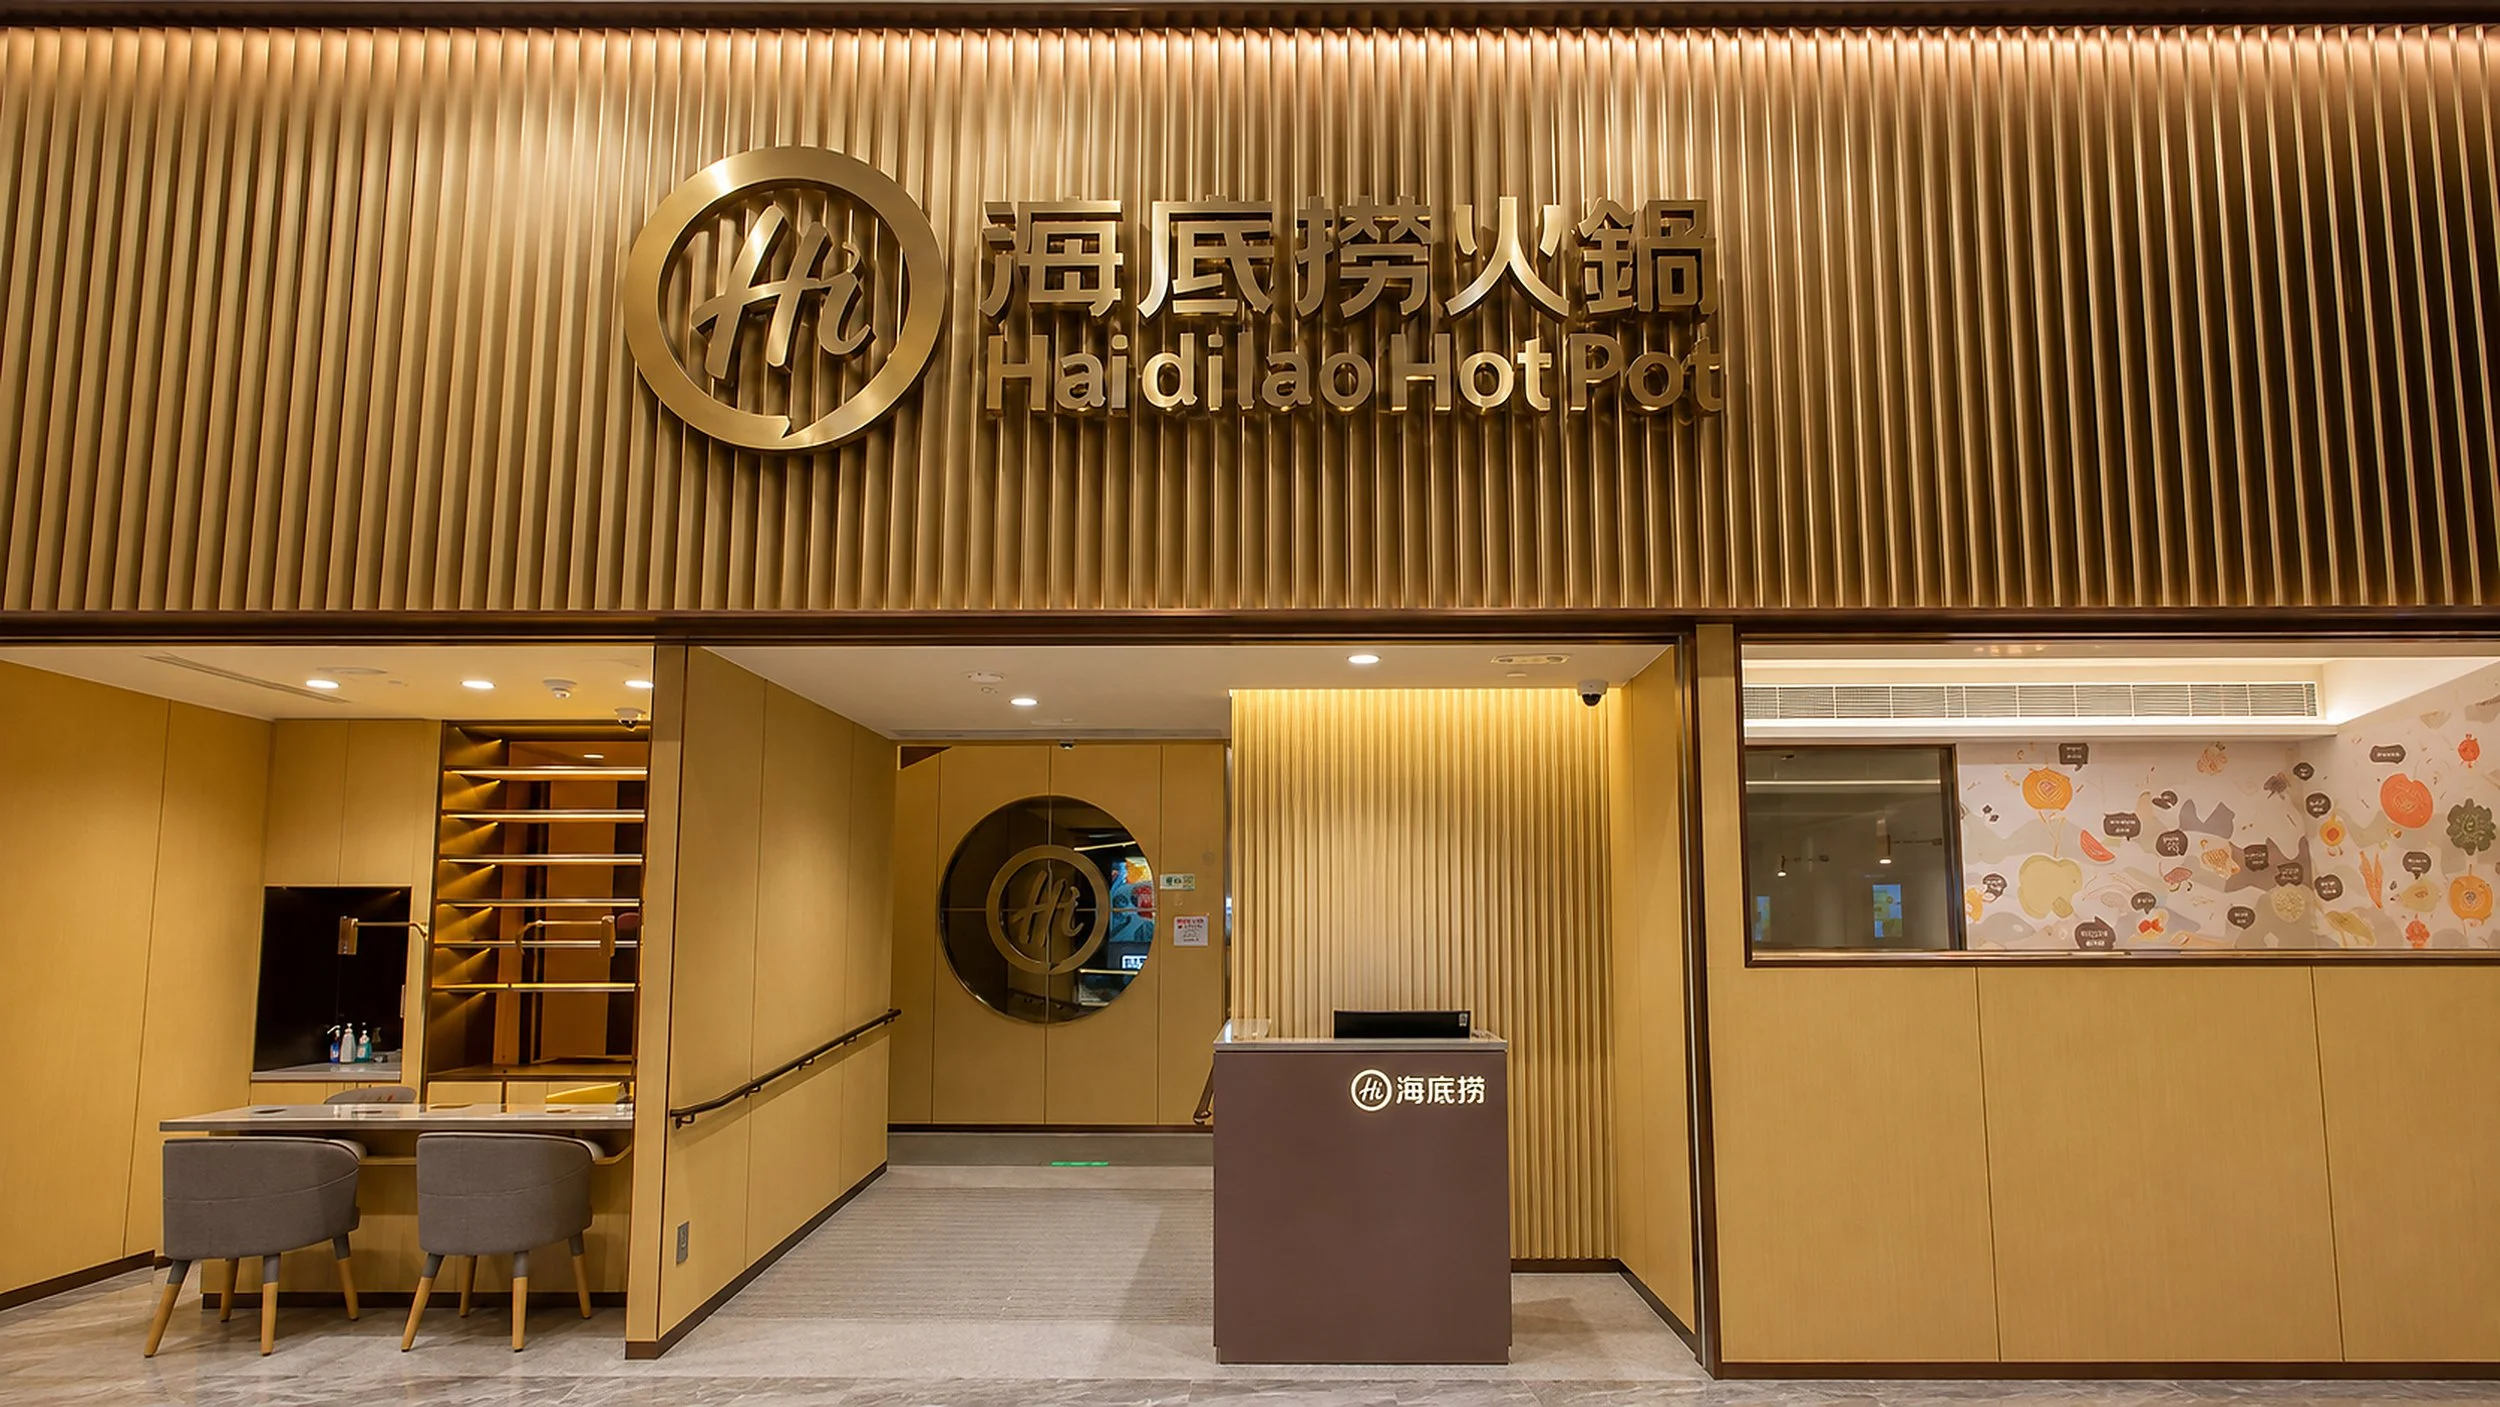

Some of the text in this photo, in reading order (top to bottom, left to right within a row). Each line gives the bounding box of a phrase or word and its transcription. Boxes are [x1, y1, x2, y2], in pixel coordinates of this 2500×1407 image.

[691, 203, 877, 380] Hi
[980, 195, 1717, 318] 海底撈火鍋
[986, 328, 1722, 414] Haidilao Hot Pot
[1011, 870, 1085, 948] Hi
[1359, 1075, 1486, 1105] Hi 海底捞
